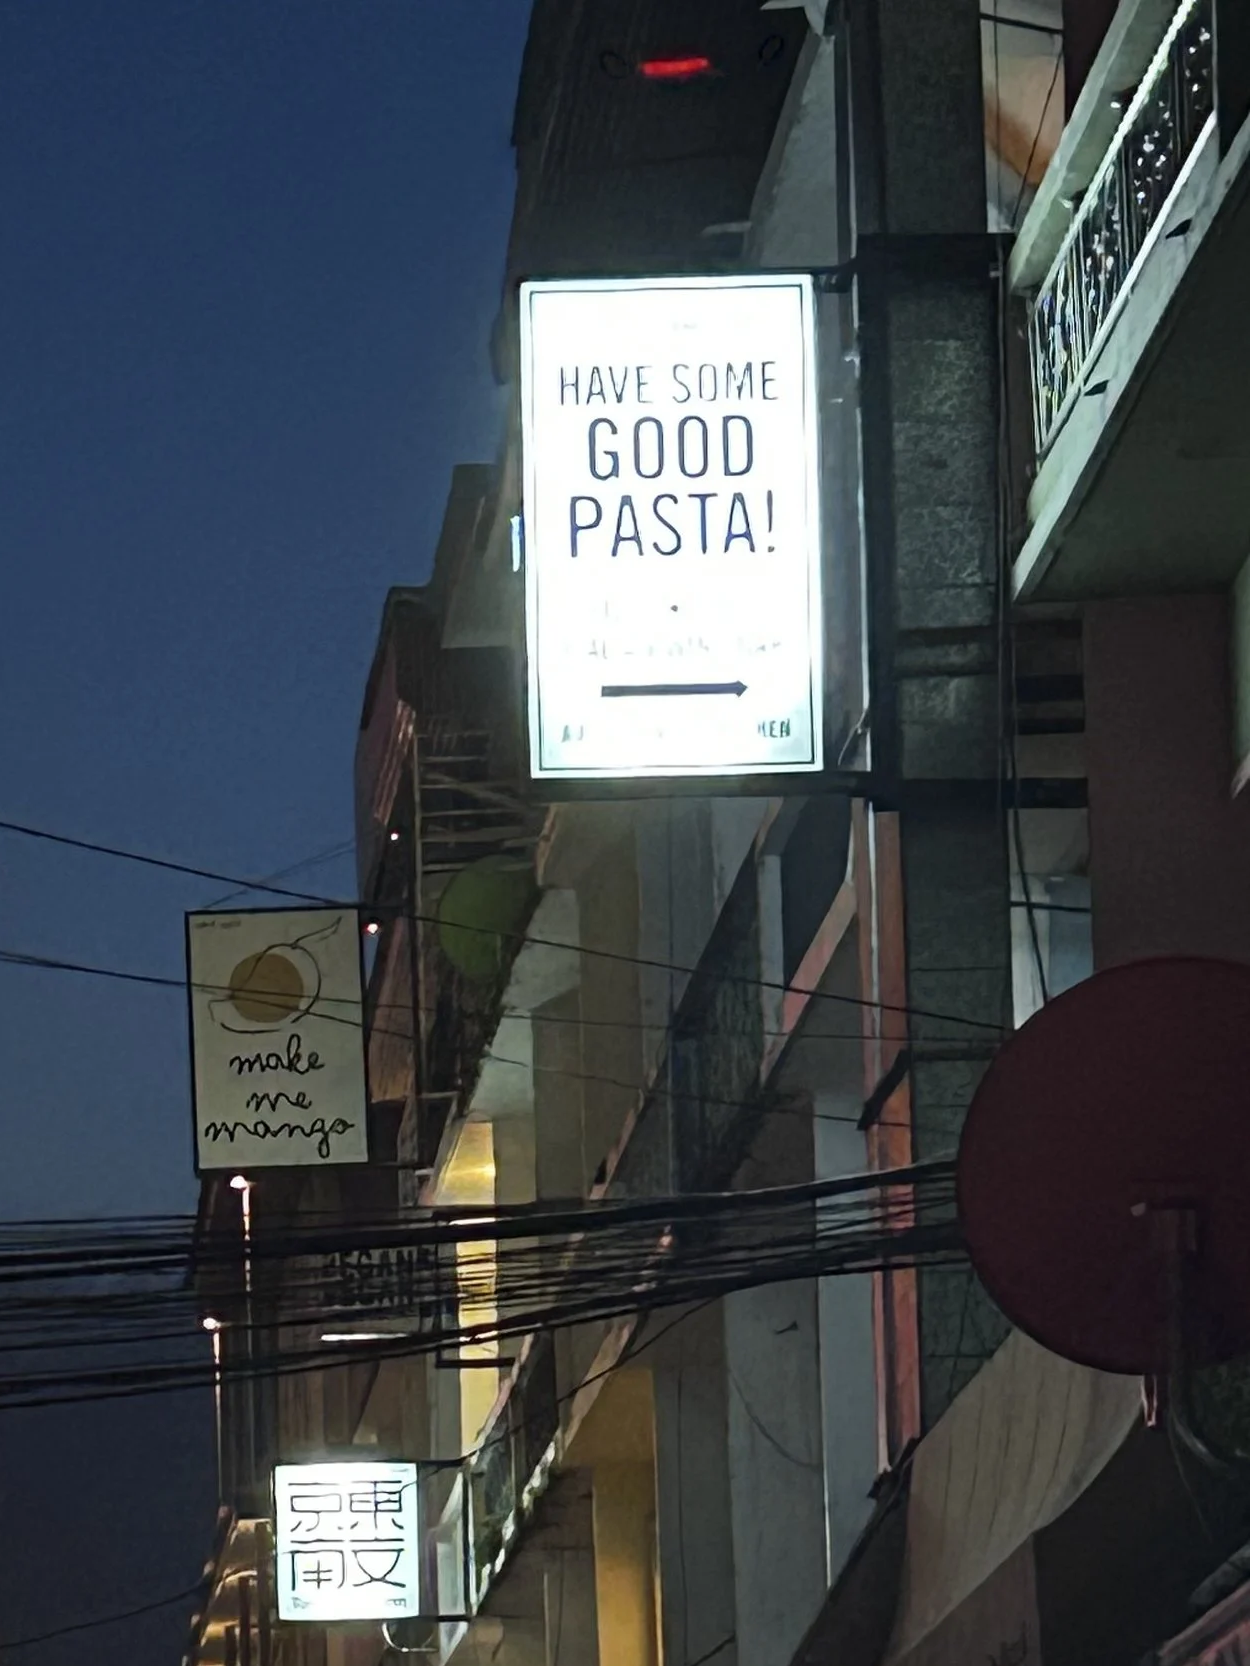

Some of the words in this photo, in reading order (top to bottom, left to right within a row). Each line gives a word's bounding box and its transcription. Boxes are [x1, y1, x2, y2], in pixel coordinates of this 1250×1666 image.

[559, 365, 654, 406] HAVE
[672, 361, 780, 404] SOME
[588, 414, 754, 481] GOOD
[569, 489, 776, 558] PASTA!
[229, 1033, 327, 1076] make
[246, 1091, 313, 1113] me
[204, 1117, 356, 1160] mango
